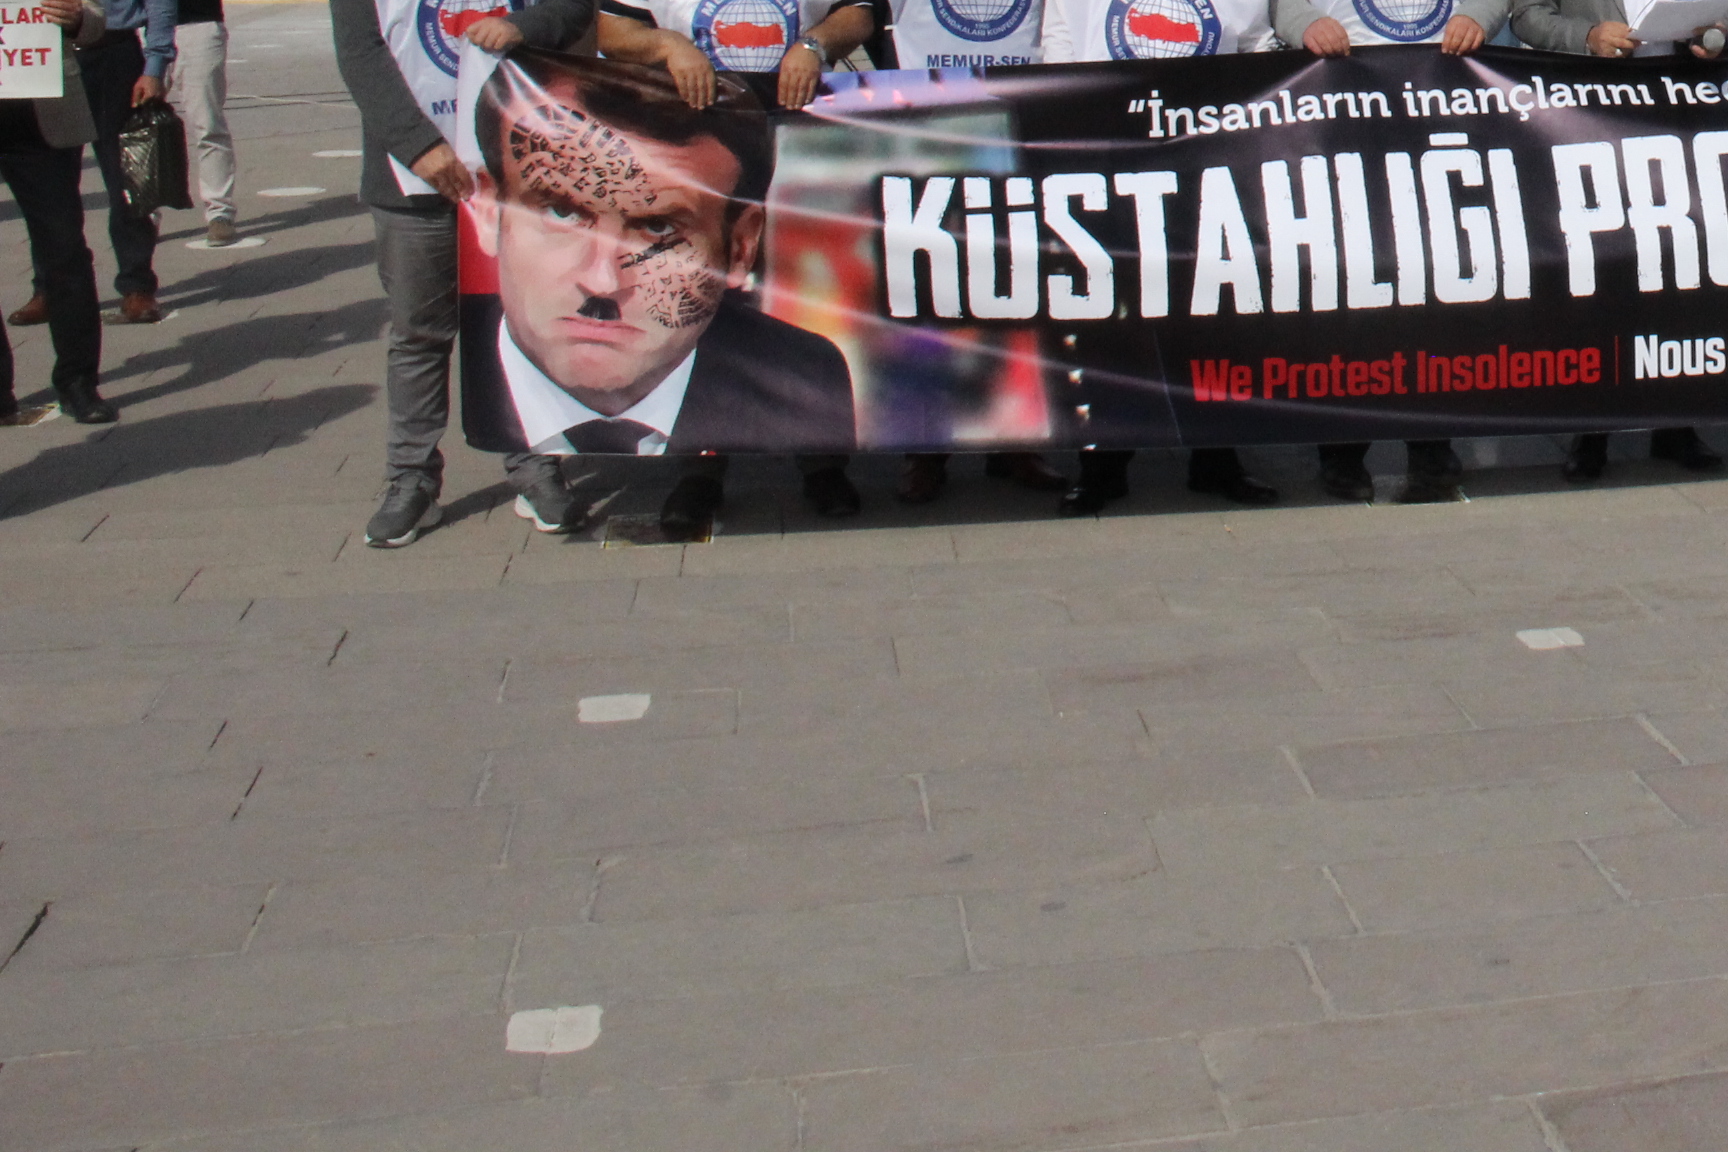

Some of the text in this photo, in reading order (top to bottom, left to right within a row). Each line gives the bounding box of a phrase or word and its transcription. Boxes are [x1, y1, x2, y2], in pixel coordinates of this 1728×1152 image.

[1402, 75, 1656, 124] inançlarını
[880, 132, 1532, 320] KÜSTAHLIĞI
[1190, 345, 1600, 404] We Protest Insolence
[1634, 335, 1726, 379] Nous
